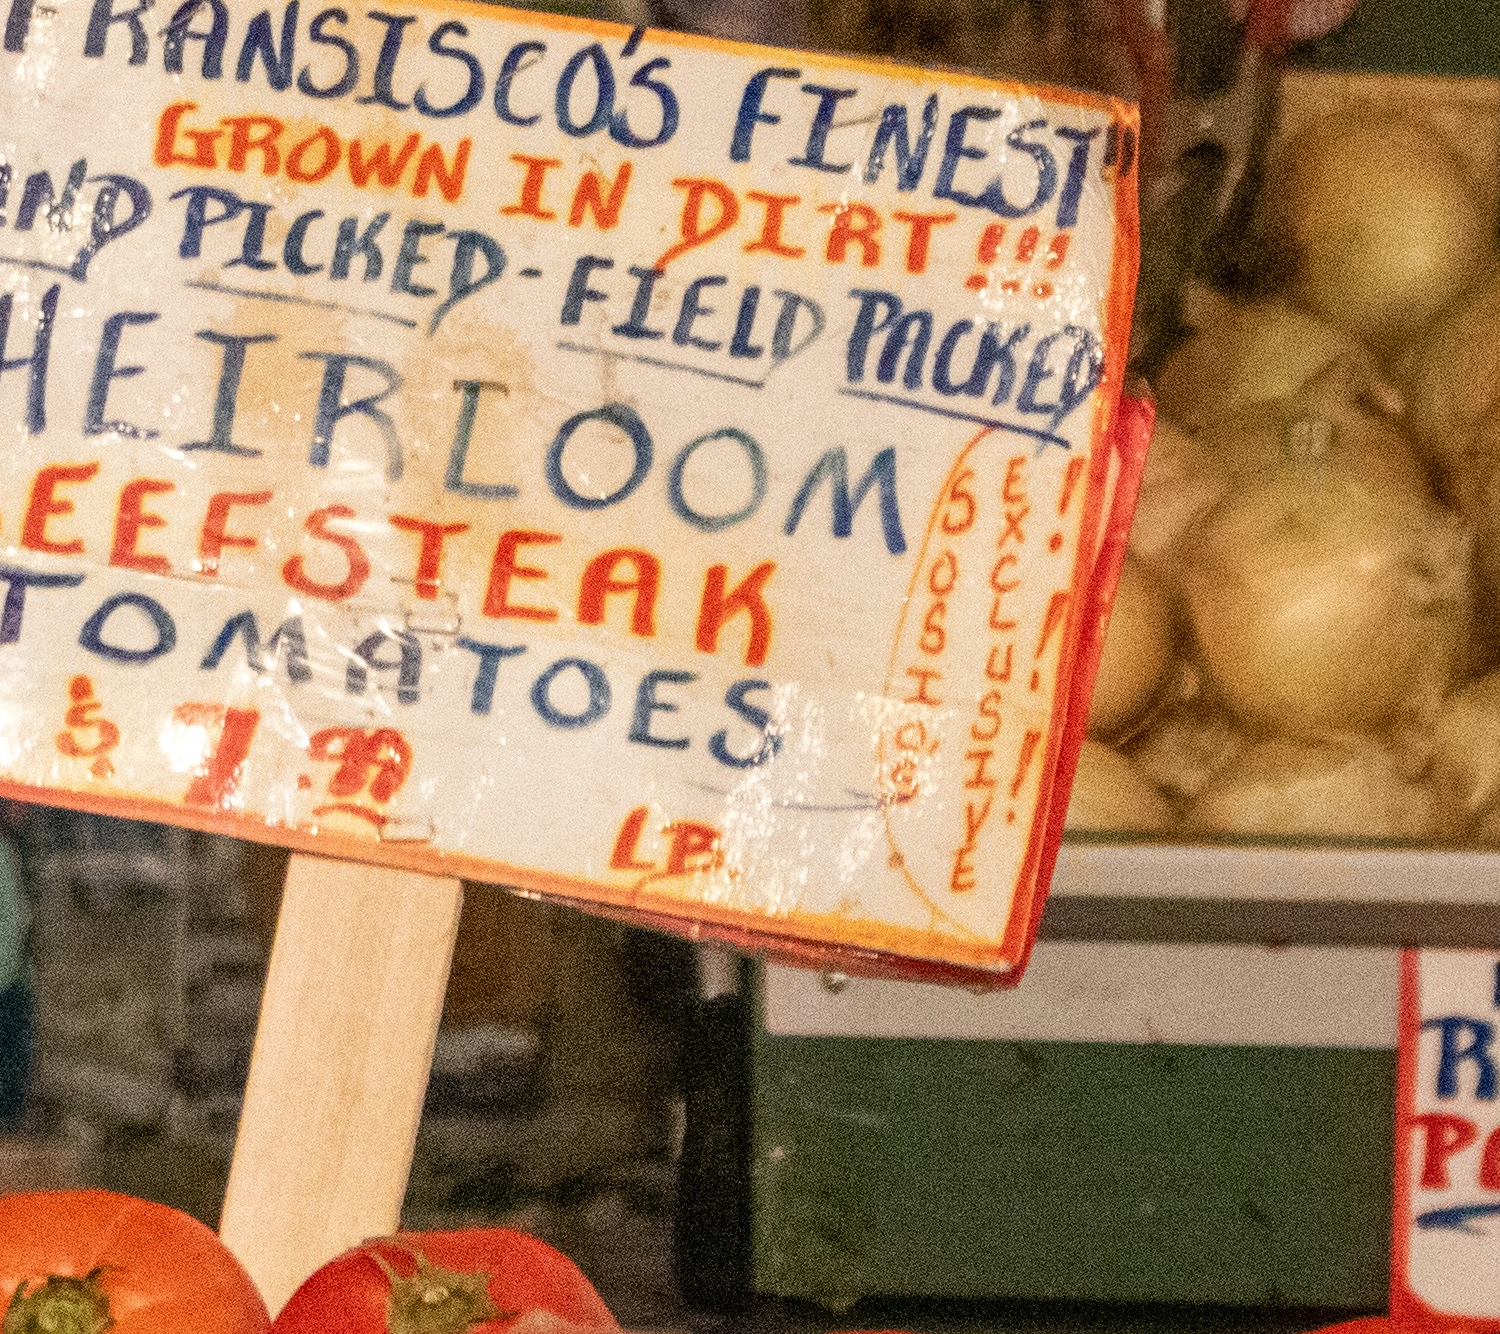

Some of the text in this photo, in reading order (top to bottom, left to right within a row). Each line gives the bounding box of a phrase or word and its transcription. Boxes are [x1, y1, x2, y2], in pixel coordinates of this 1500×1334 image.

[152, 101, 472, 203] GROWN
[500, 153, 632, 230] IN
[847, 287, 1106, 435] PACKED
[950, 455, 1029, 893] EXCLUSIVE
